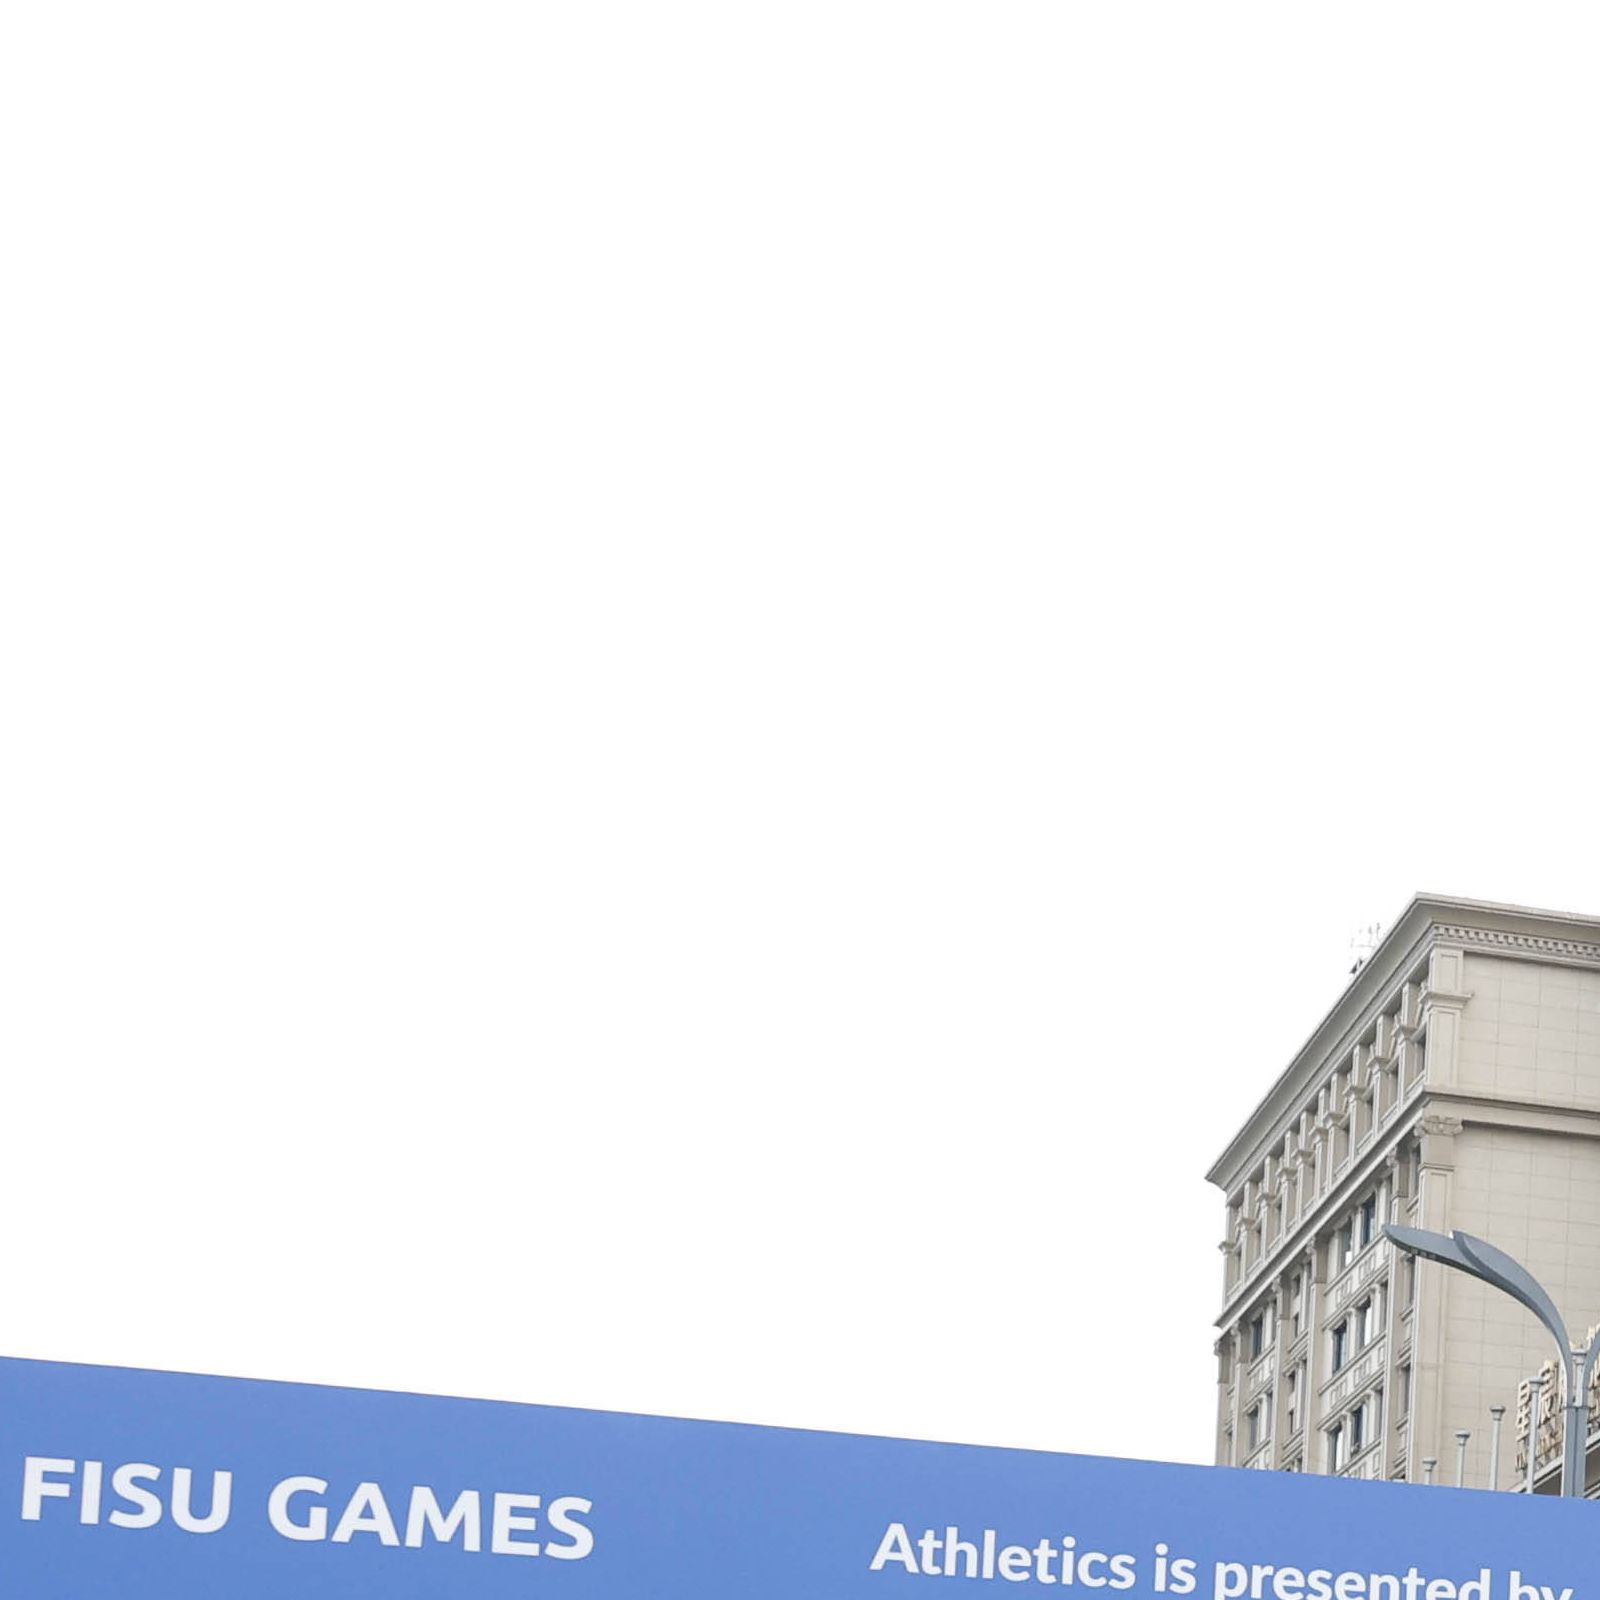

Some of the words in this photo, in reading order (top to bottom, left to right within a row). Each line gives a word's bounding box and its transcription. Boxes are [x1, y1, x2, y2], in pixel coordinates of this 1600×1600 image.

[21, 1456, 232, 1533] FISU
[267, 1476, 594, 1560] GAMES
[869, 1523, 1136, 1590] Athletics
[1154, 1543, 1197, 1594] is
